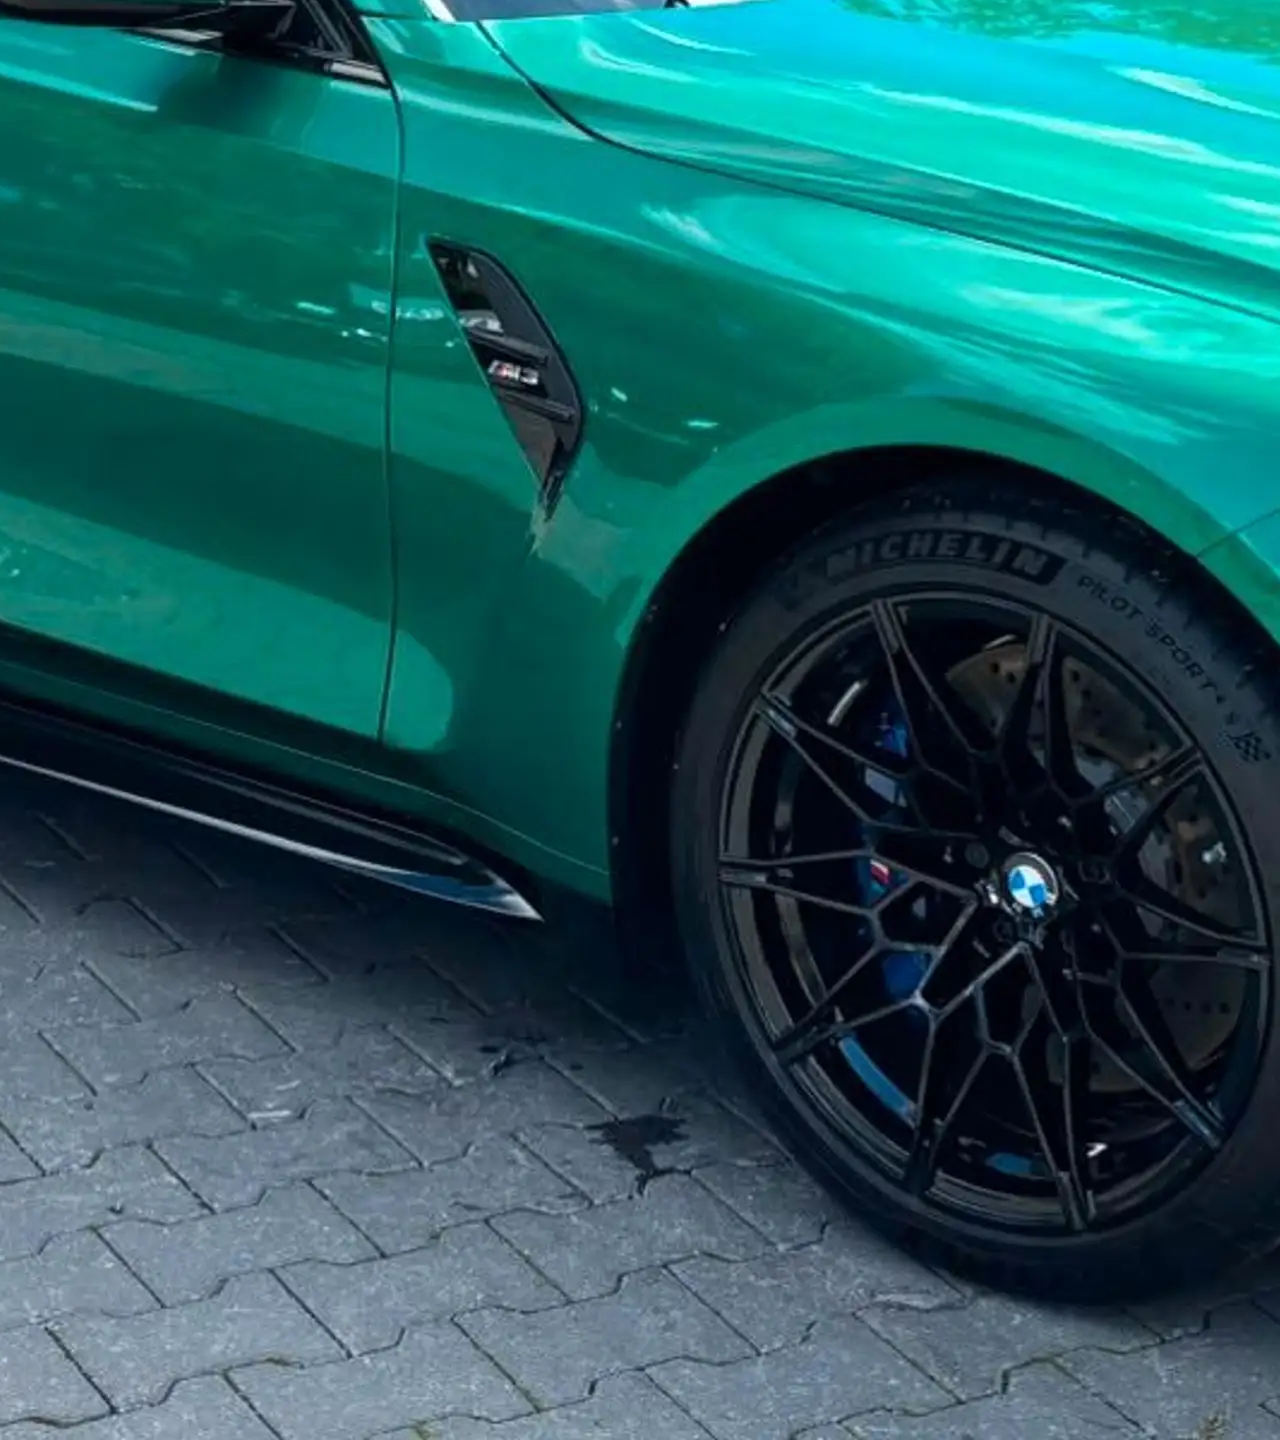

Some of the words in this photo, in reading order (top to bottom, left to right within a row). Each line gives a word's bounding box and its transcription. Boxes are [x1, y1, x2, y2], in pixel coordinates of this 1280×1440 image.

[826, 530, 1049, 578] MICHELIN
[1077, 574, 1144, 620] PILOT
[1144, 615, 1218, 693] SPORT
